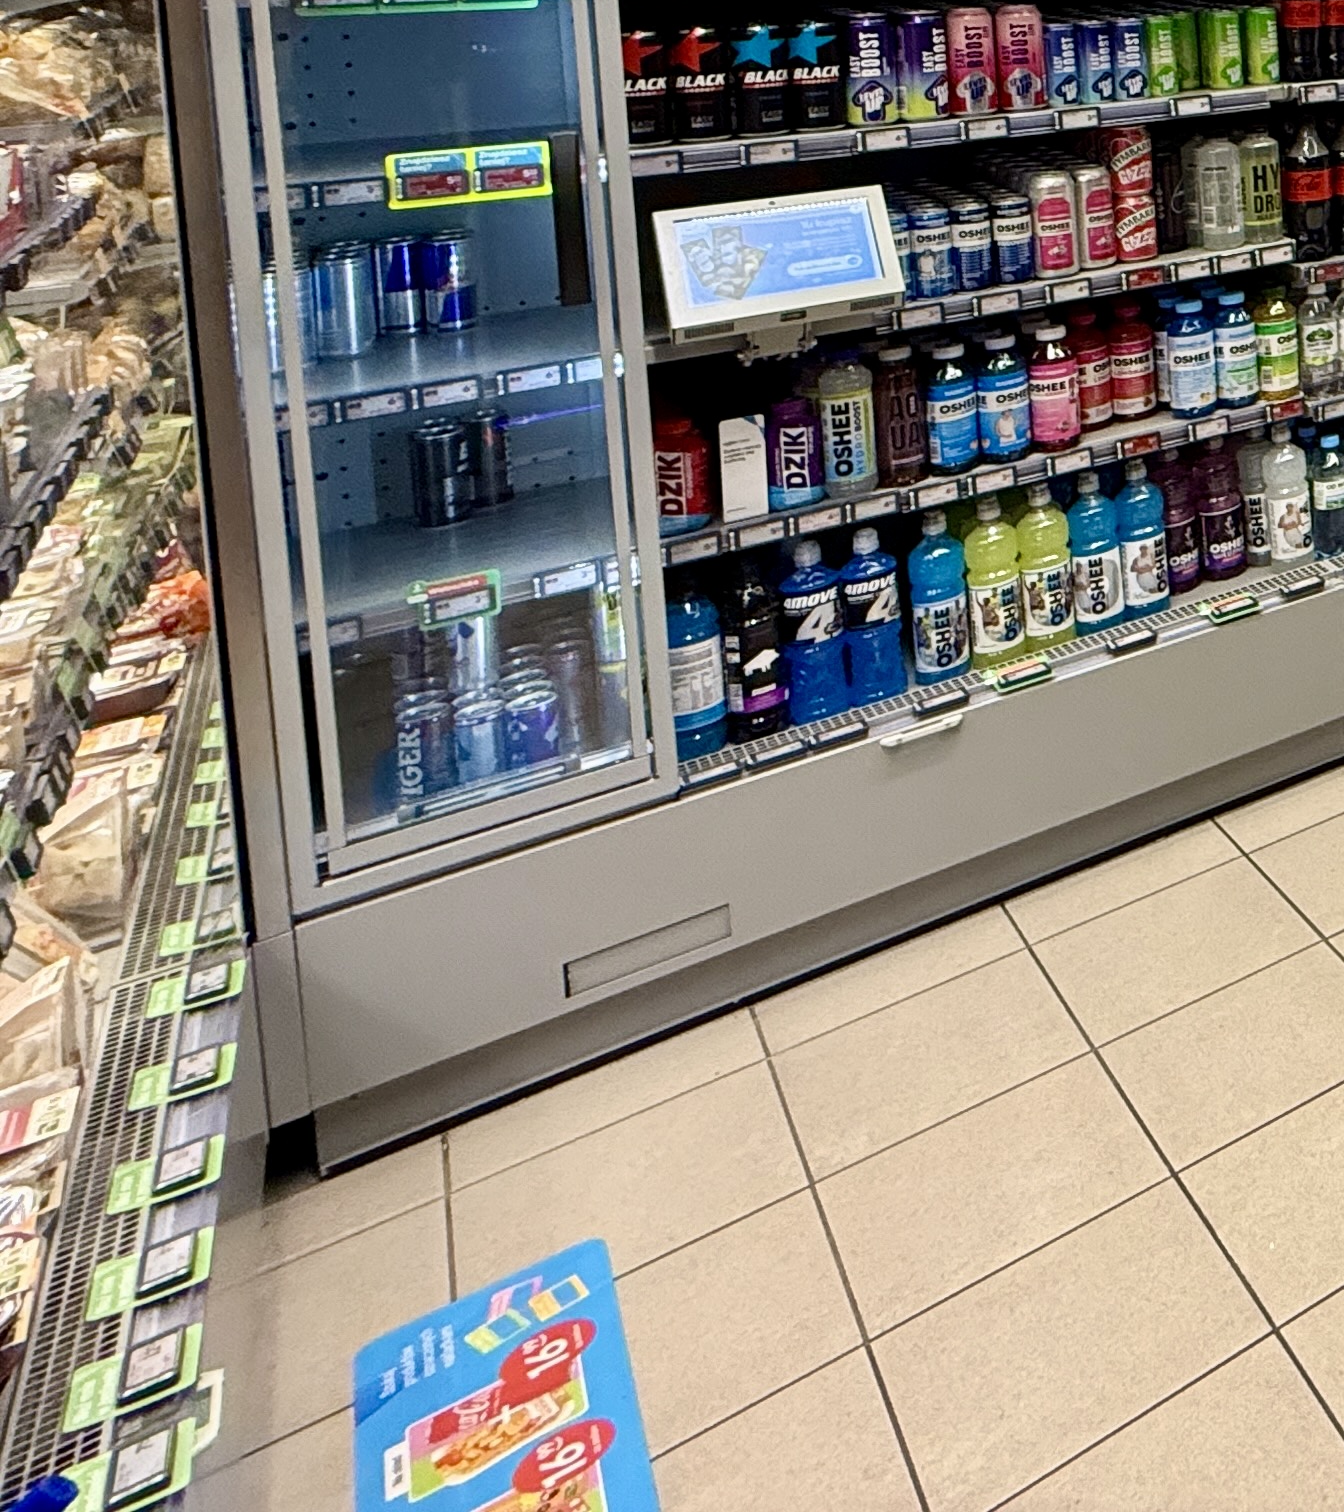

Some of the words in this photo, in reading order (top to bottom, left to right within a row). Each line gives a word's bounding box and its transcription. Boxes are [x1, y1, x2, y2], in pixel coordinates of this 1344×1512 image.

[676, 73, 725, 88] BLACK
[793, 65, 840, 80] BLACK
[1112, 352, 1152, 369] OSHEE
[1173, 350, 1212, 366] OSHEE
[784, 430, 807, 489] DZIK
[831, 402, 853, 478] OSHEE
[659, 454, 684, 516] DZIK
[1092, 555, 1106, 615] OSHEE
[936, 605, 952, 669] OSHEE
